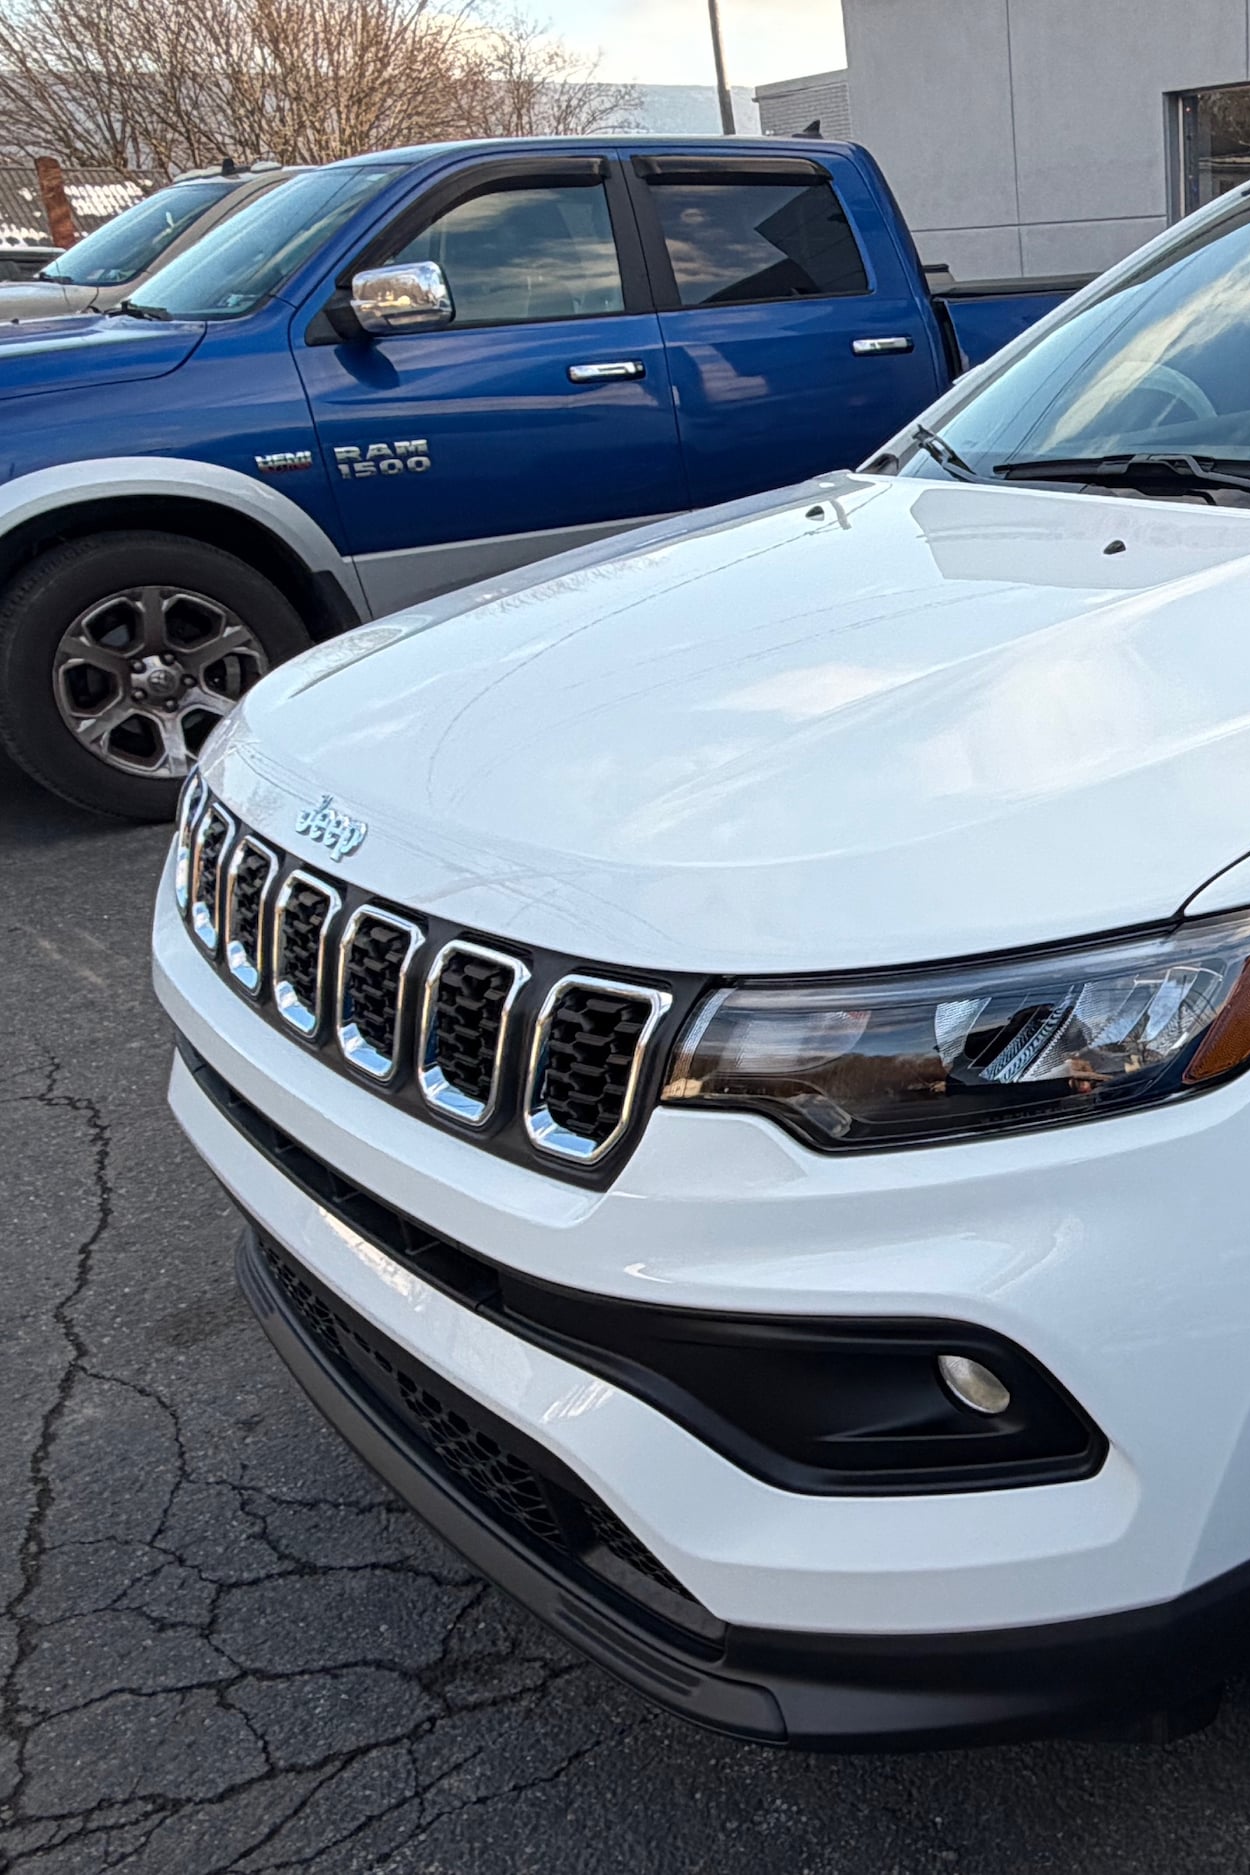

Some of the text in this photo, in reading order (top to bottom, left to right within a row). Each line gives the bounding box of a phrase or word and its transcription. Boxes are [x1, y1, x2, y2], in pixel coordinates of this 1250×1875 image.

[255, 451, 312, 469] HEMI
[334, 439, 427, 460] RAM
[337, 457, 431, 479] 1500
[295, 794, 368, 863] Jeep
